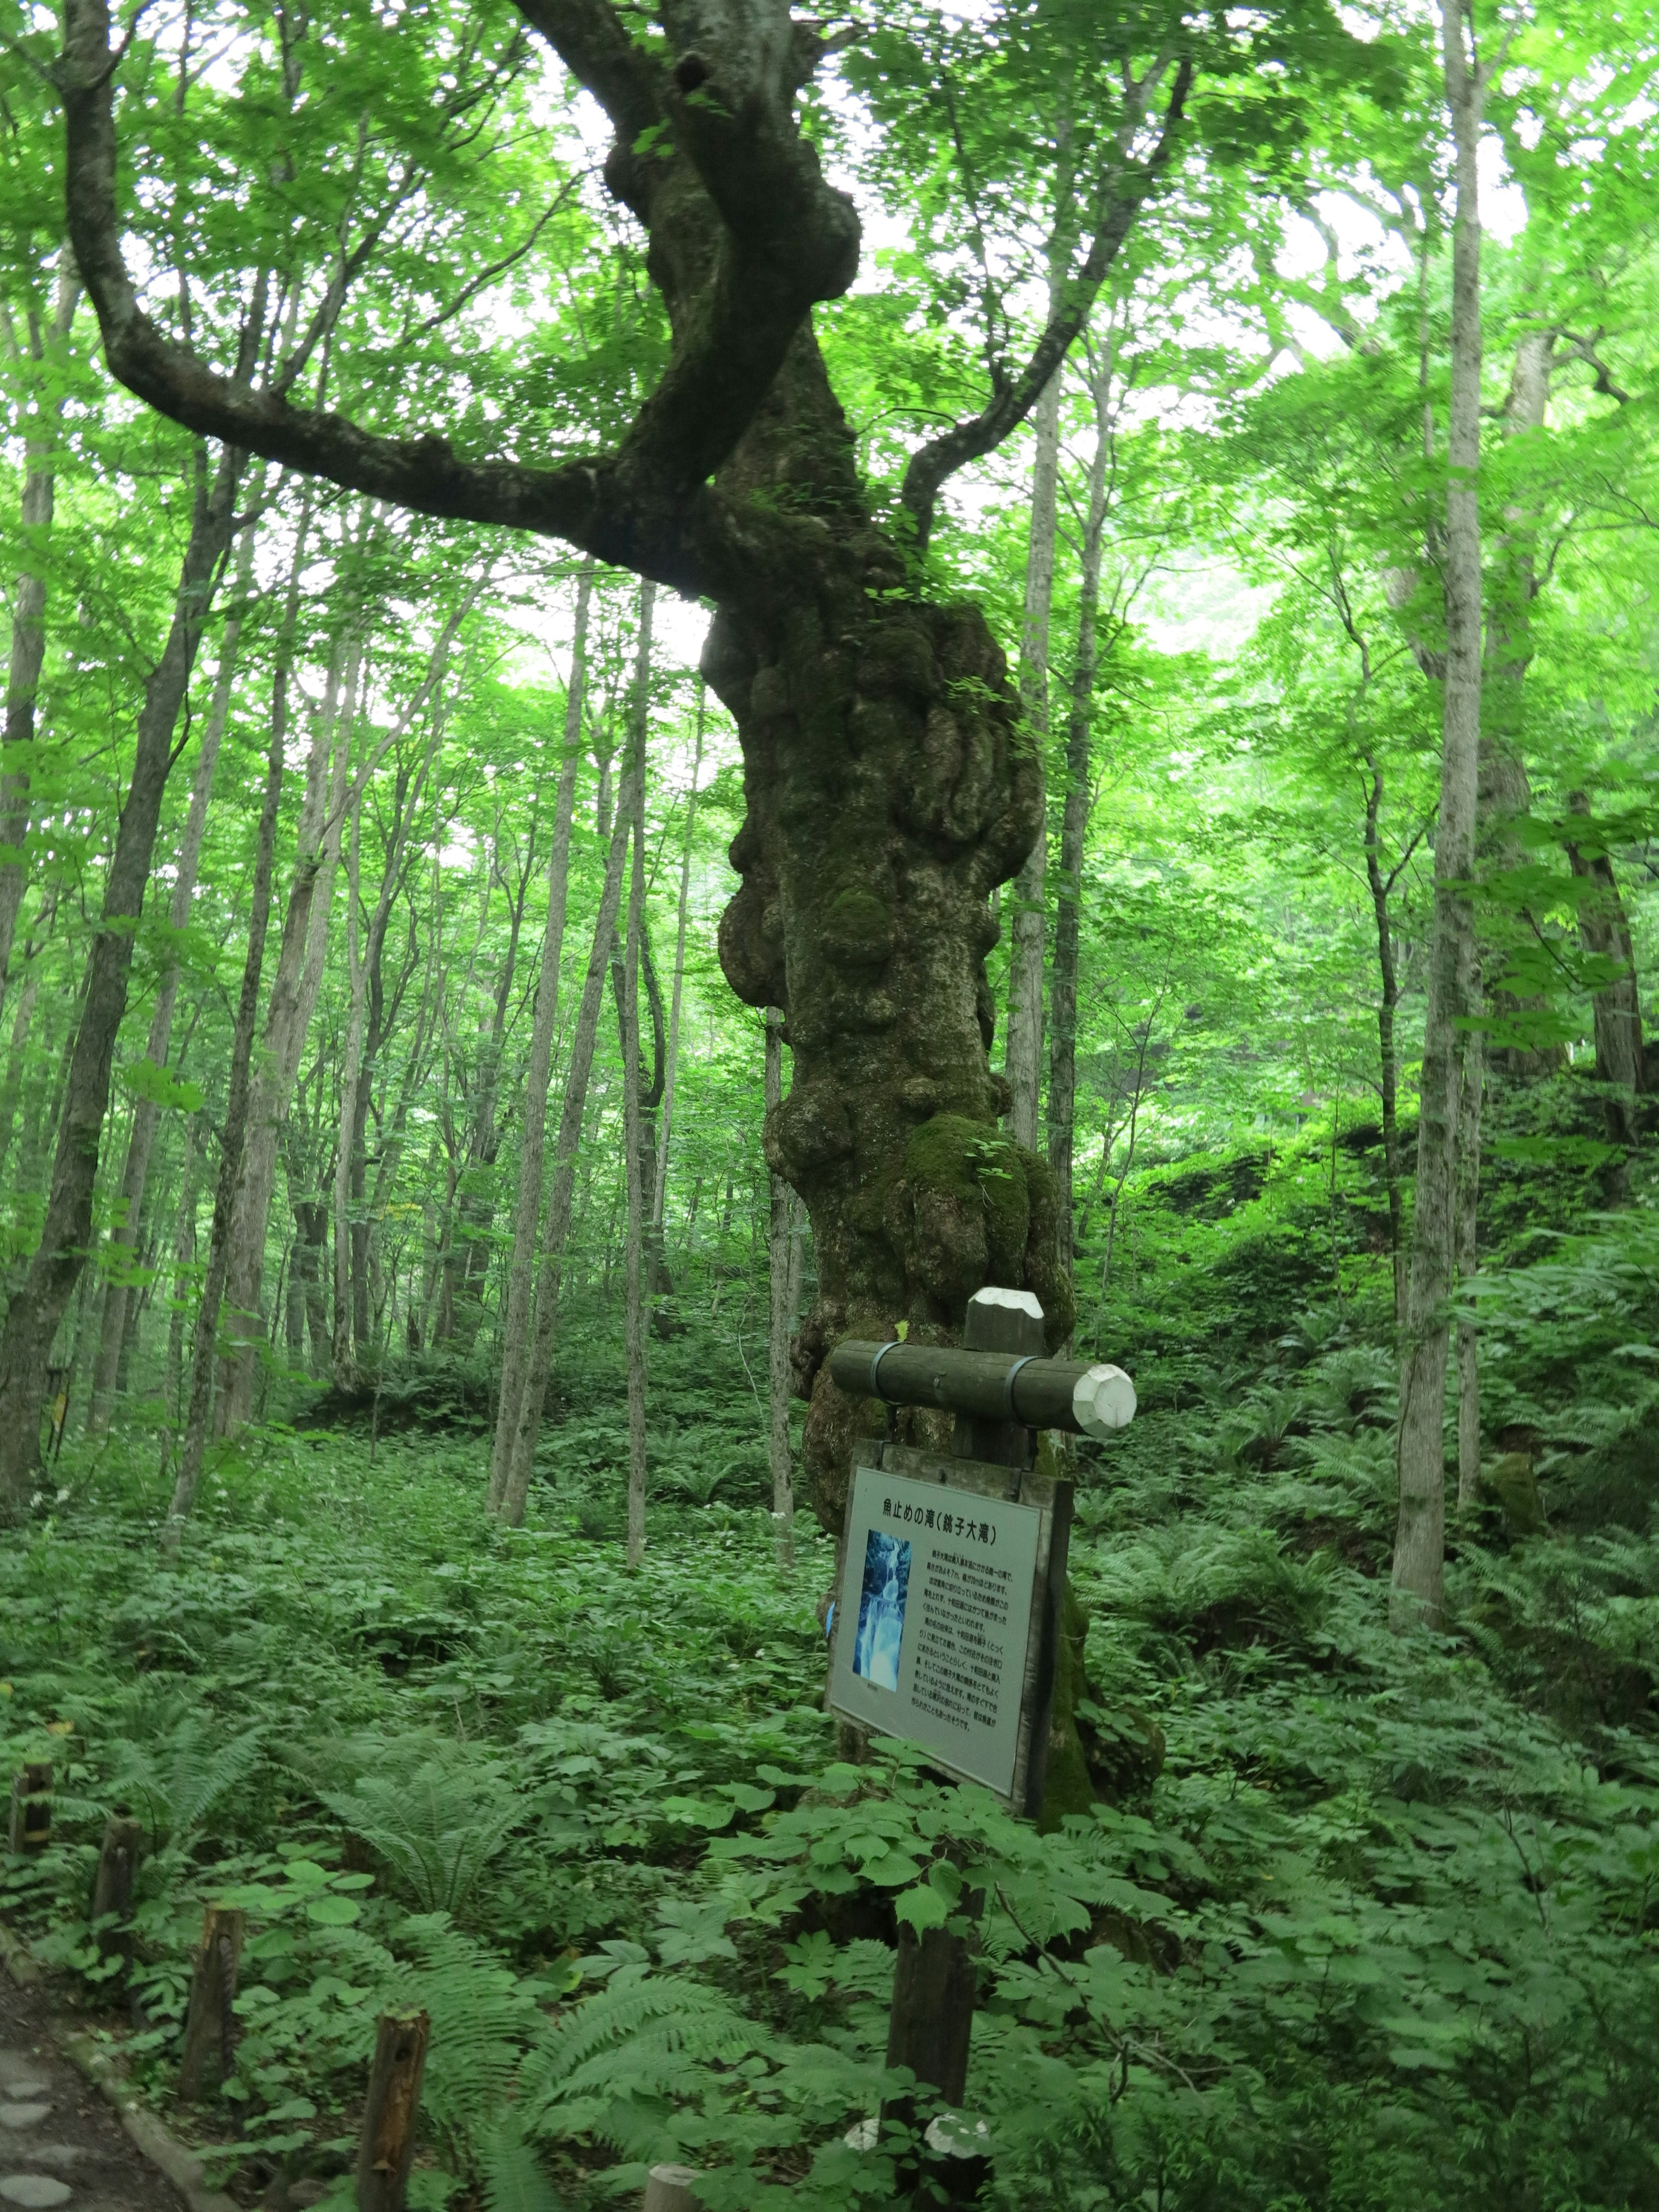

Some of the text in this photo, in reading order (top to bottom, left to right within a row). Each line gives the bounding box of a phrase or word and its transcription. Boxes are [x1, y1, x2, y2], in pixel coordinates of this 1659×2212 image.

[882, 1498, 996, 1546] 魚止めの滝(銚子大滝)
